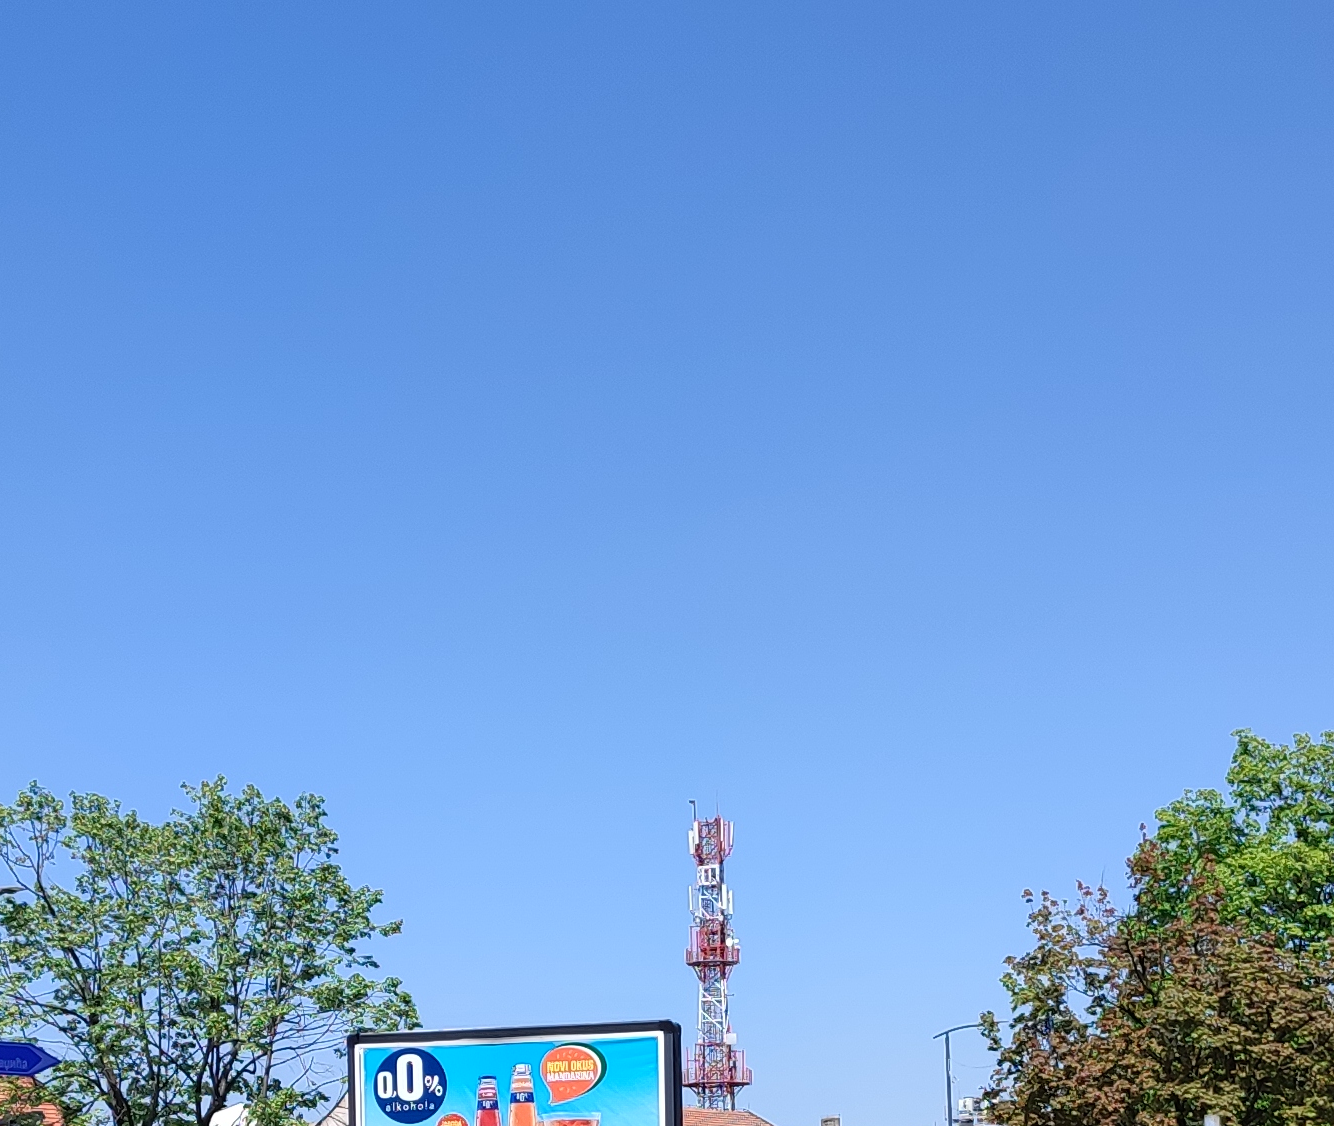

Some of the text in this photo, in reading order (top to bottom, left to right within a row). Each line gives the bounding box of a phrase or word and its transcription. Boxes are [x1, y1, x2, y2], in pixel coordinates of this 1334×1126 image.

[547, 1060, 594, 1072] NOVI OKUS
[547, 1071, 594, 1081] MANDARINA
[385, 1100, 435, 1113] alkohola
